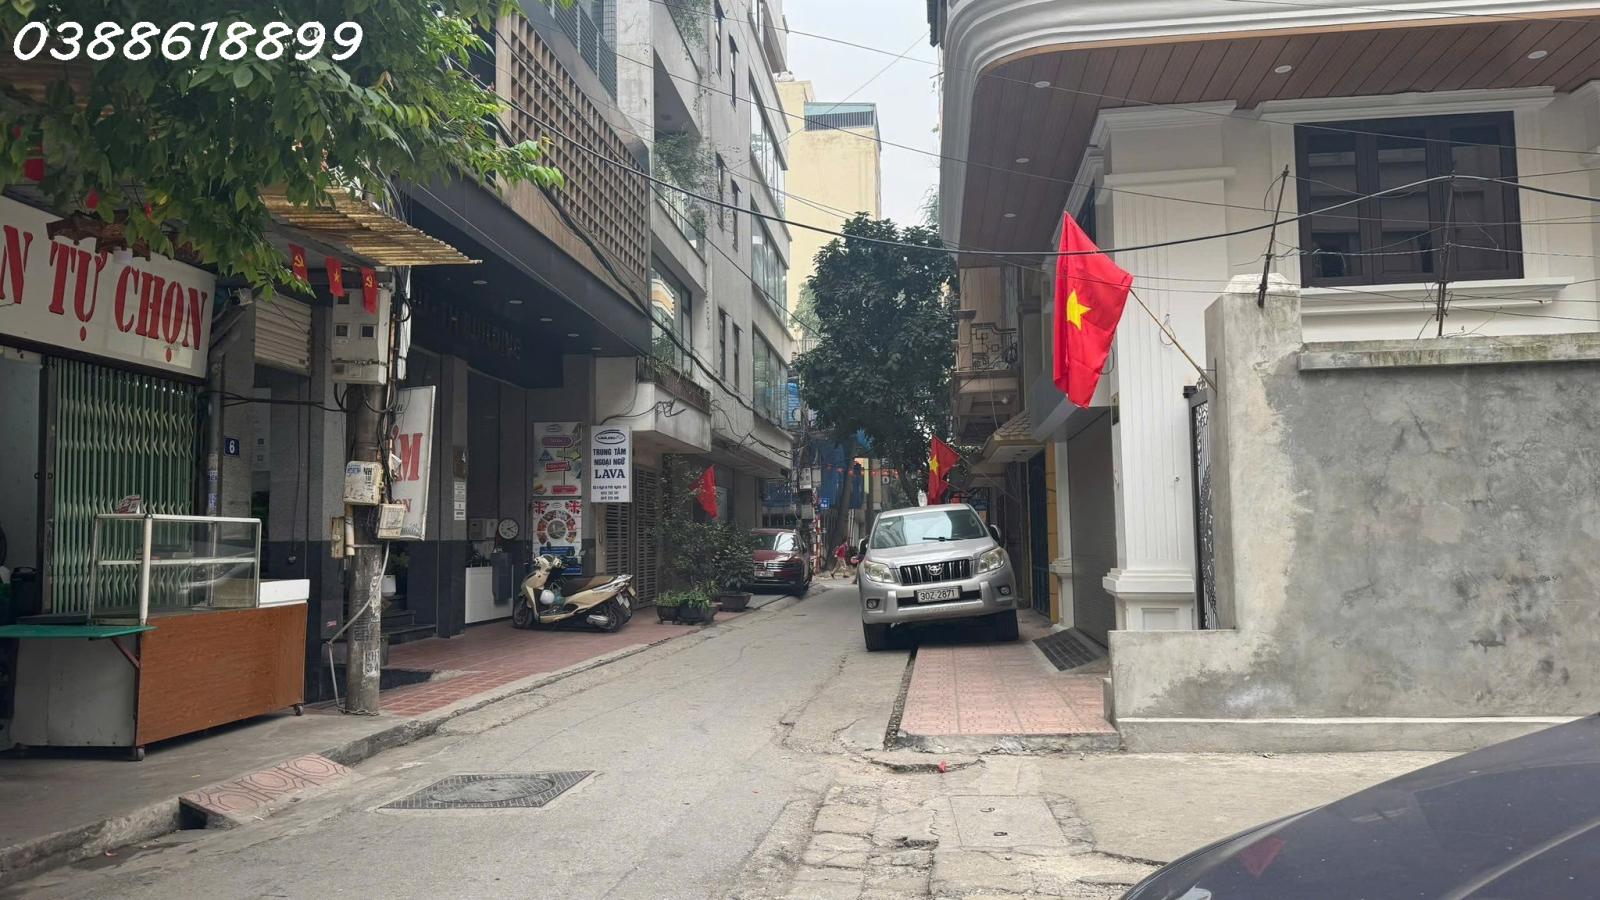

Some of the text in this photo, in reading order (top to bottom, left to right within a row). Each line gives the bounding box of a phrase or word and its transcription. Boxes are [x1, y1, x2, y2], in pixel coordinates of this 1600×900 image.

[49, 241, 108, 342] TỰ
[114, 266, 208, 362] CHỌN
[593, 447, 626, 456] TRUNG TÂM
[594, 457, 626, 467] NGOẠI NGỮ
[594, 469, 626, 479] LAVA
[920, 589, 955, 601] 30Z-2871
